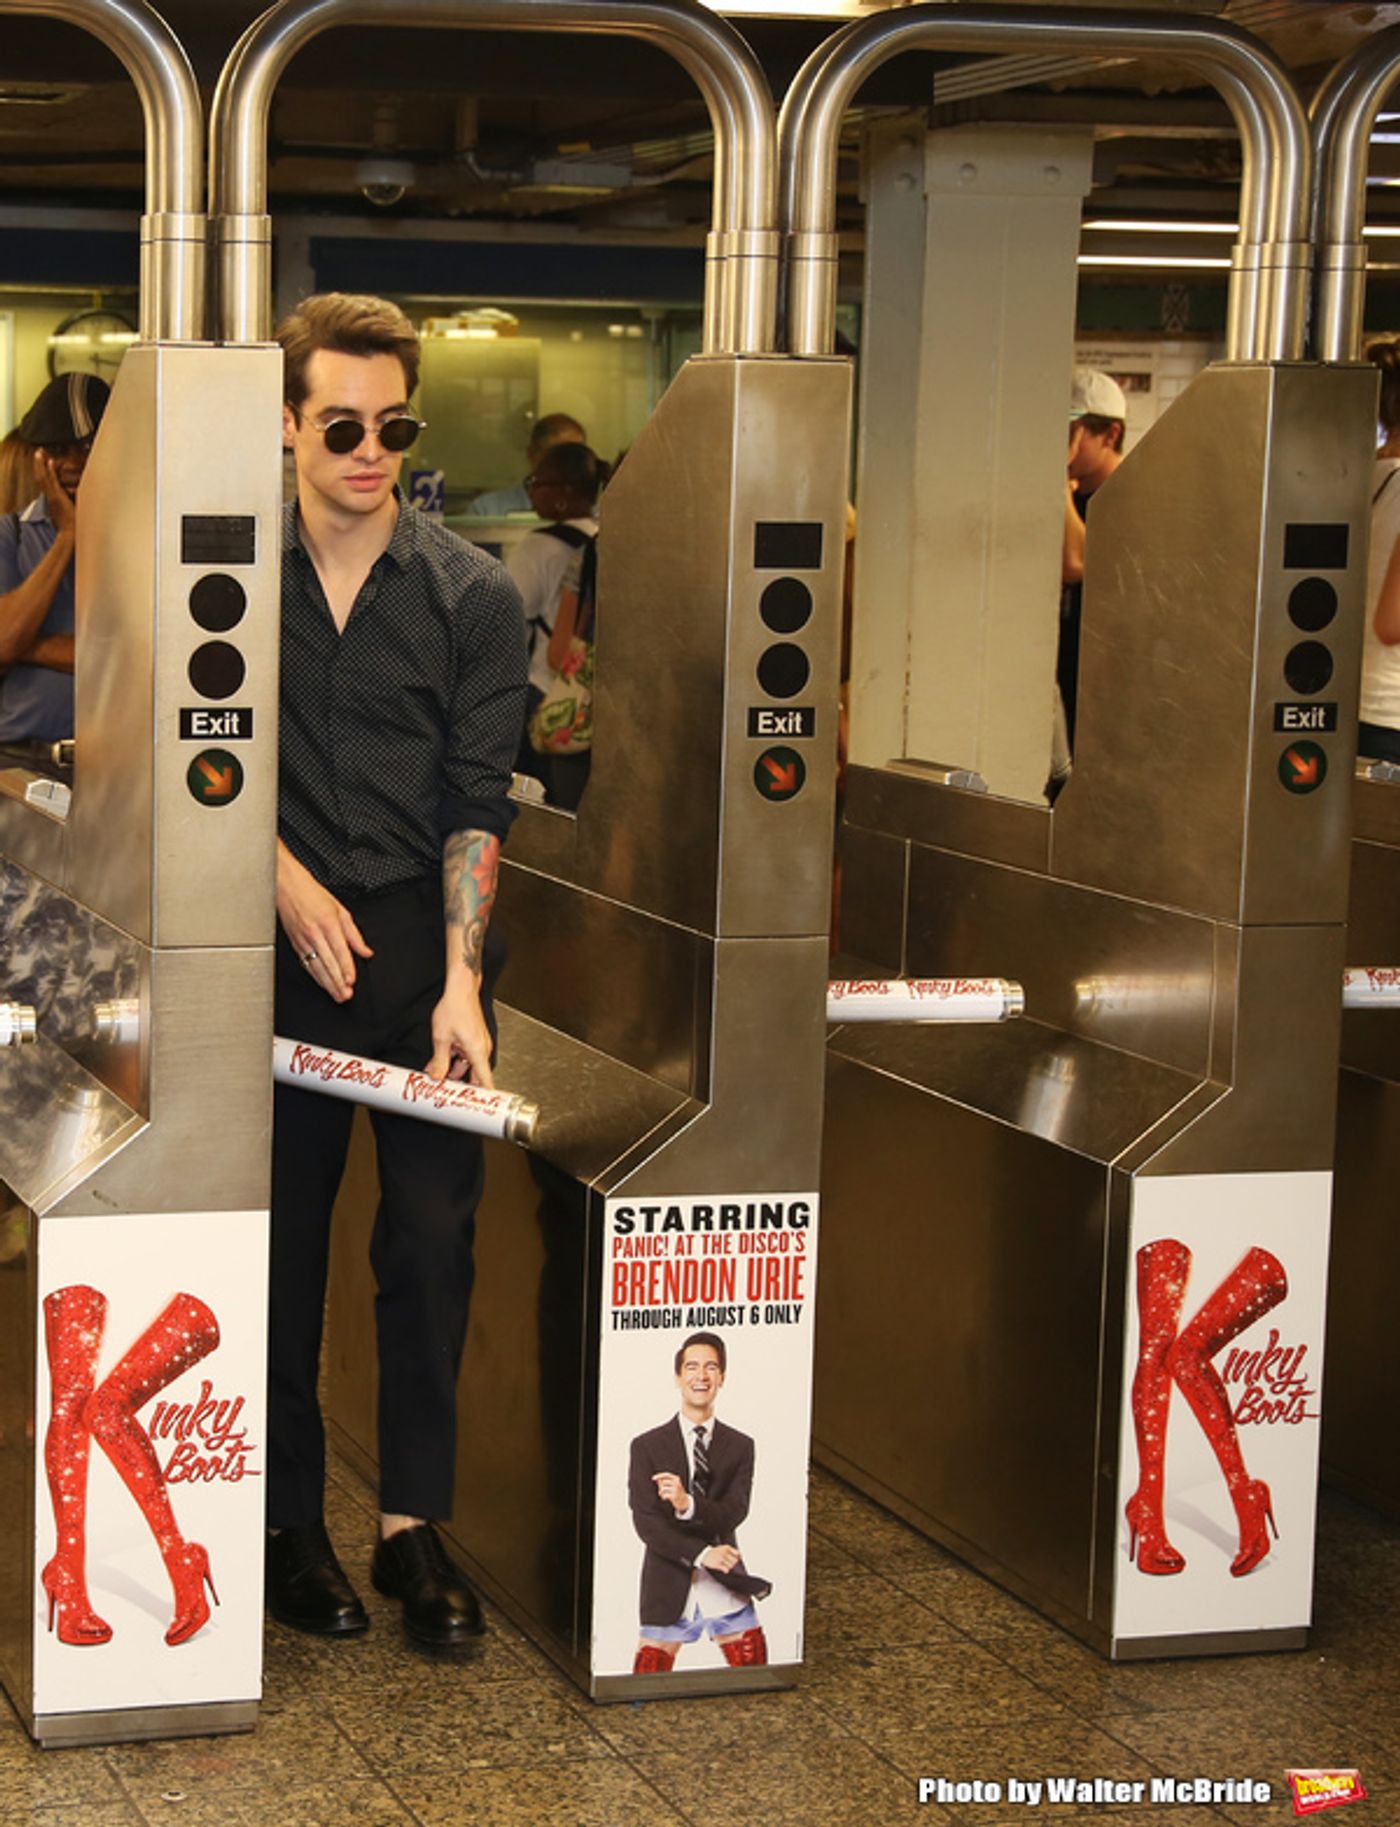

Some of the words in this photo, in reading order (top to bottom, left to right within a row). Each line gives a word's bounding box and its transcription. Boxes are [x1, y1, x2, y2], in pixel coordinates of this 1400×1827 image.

[191, 712, 239, 735] Exit
[758, 711, 802, 733] Exit
[1283, 706, 1325, 728] Exit
[289, 1044, 339, 1080] Kinky
[338, 1059, 392, 1088] Boots
[613, 1202, 810, 1235] STARRING
[612, 1234, 669, 1258] PANIC!
[674, 1233, 695, 1256] AT
[701, 1232, 732, 1255] THE
[738, 1231, 807, 1254] DISCO'S
[612, 1258, 736, 1307] BRENDON
[746, 1255, 807, 1302] URIE
[611, 1307, 683, 1331] THROUGH
[686, 1306, 746, 1327] AUGUST
[750, 1305, 760, 1325] 6
[765, 1304, 803, 1325] ONLY
[1233, 1382, 1320, 1424] Boots
[164, 1439, 262, 1483] Boots
